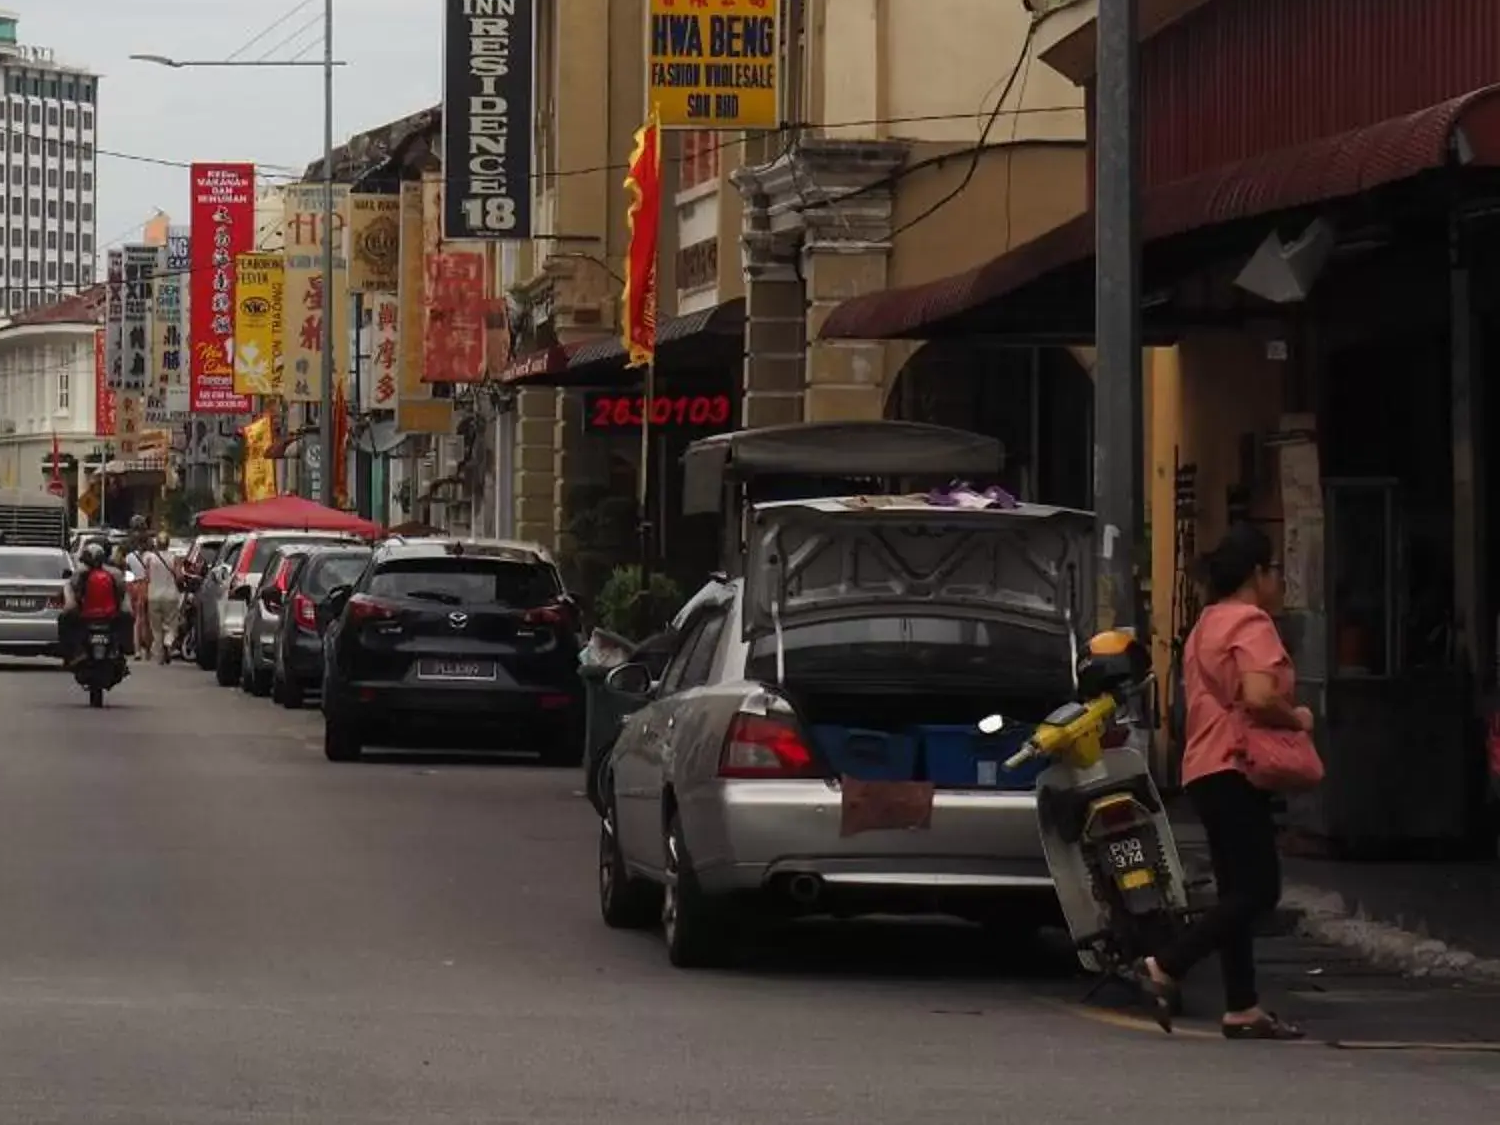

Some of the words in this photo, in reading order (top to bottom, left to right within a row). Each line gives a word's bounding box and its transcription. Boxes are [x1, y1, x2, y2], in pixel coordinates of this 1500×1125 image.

[652, 15, 703, 57] HWA
[710, 15, 773, 57] BENG
[652, 63, 701, 88] FASHION
[705, 63, 773, 89] WHOLESALE
[469, 18, 509, 195] RESIDENCE
[688, 94, 711, 118] SDN
[716, 94, 739, 118] BHD
[463, 197, 516, 230] 18
[1114, 850, 1145, 868] 374
